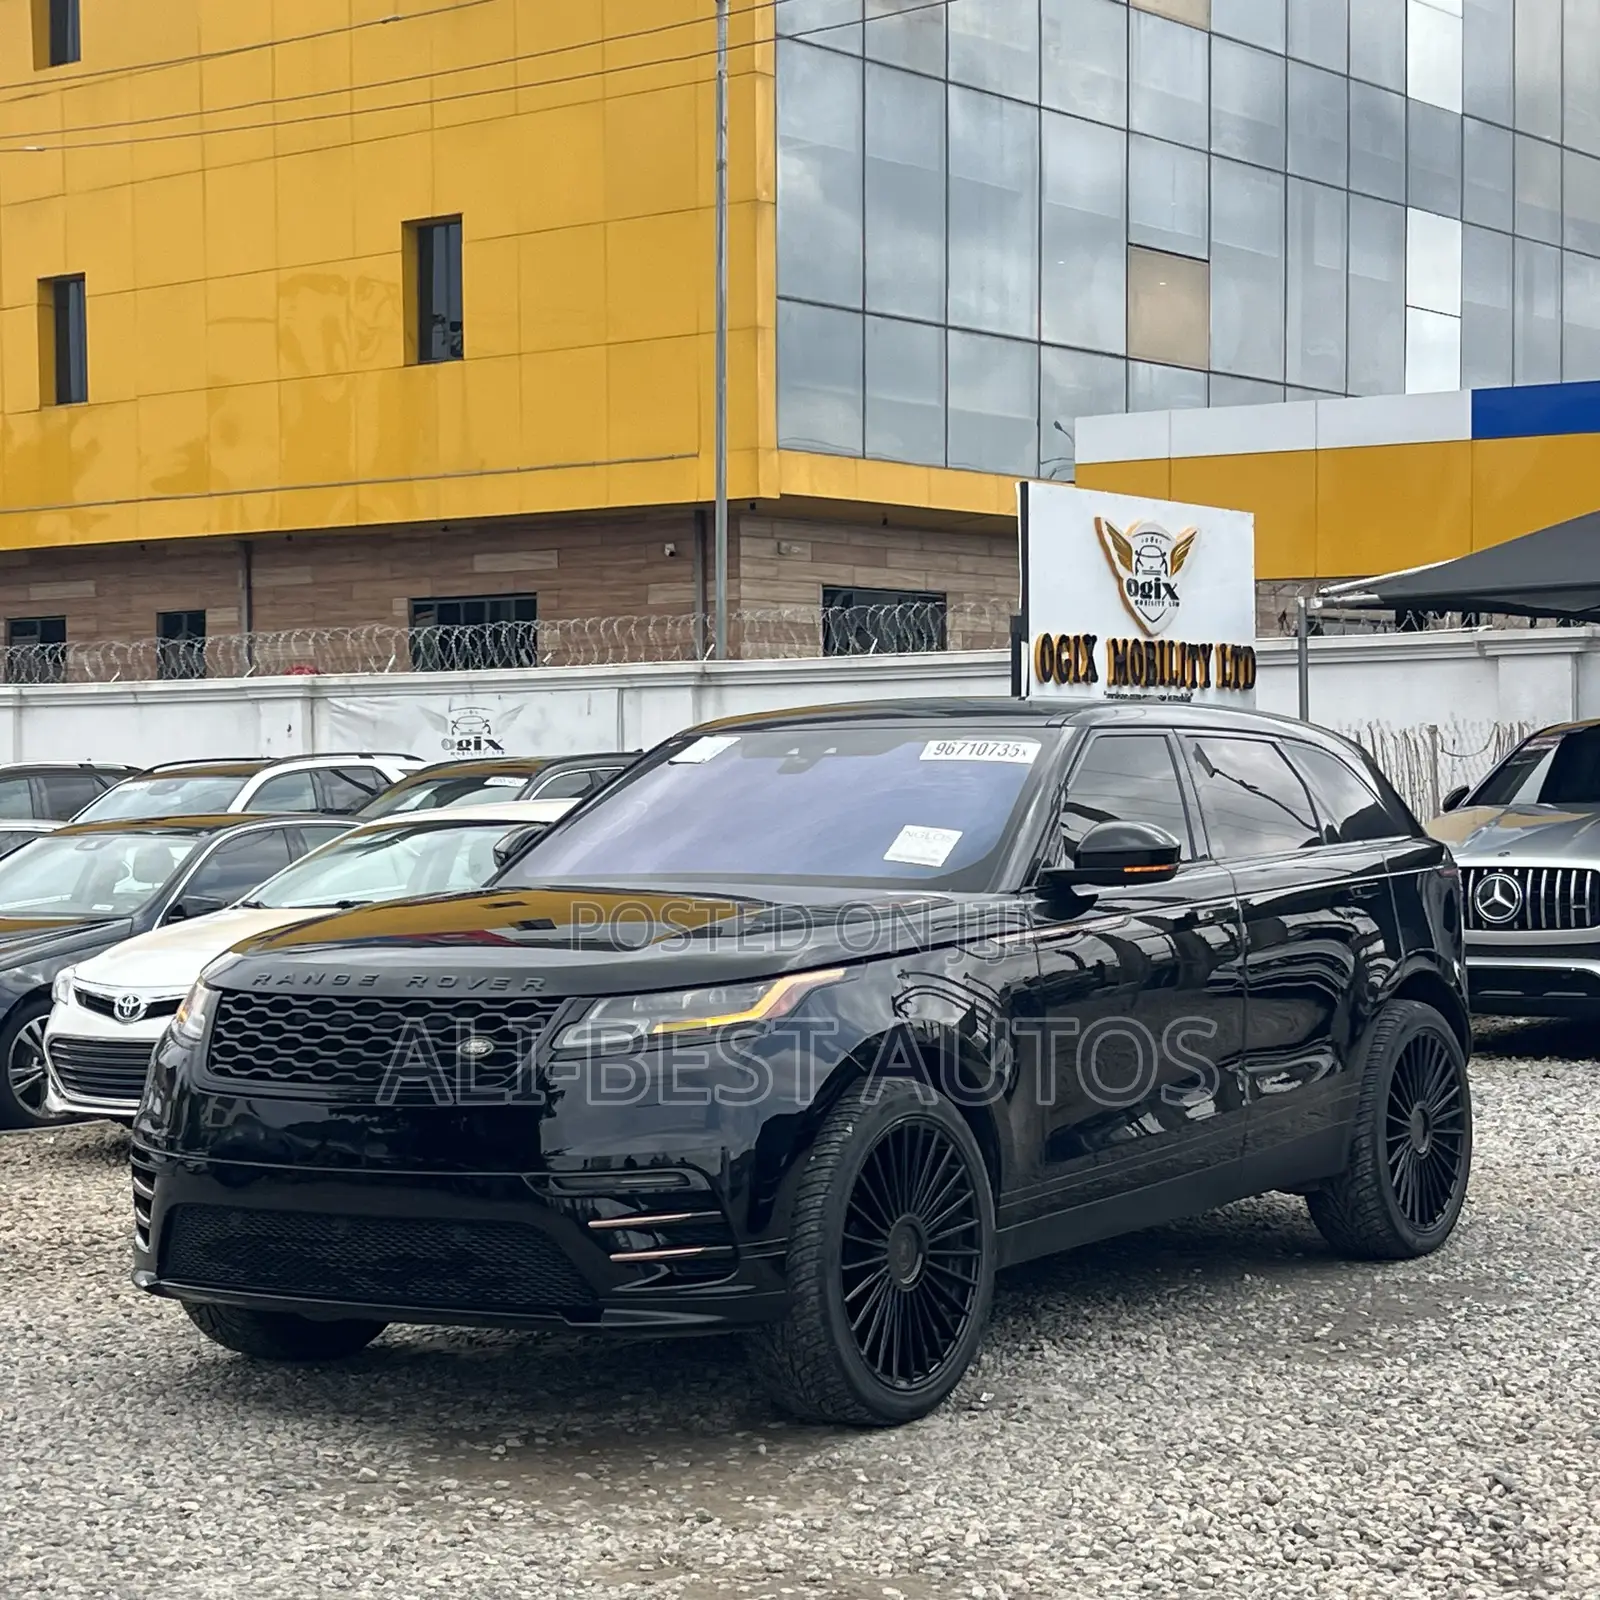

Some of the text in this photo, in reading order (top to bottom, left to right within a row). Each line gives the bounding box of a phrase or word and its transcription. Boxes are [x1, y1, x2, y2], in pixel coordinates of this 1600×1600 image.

[1034, 633, 1257, 690] OGIX MOBILITY LTD
[933, 742, 1021, 758] 96710735
[252, 972, 547, 991] RANGE ROVER
